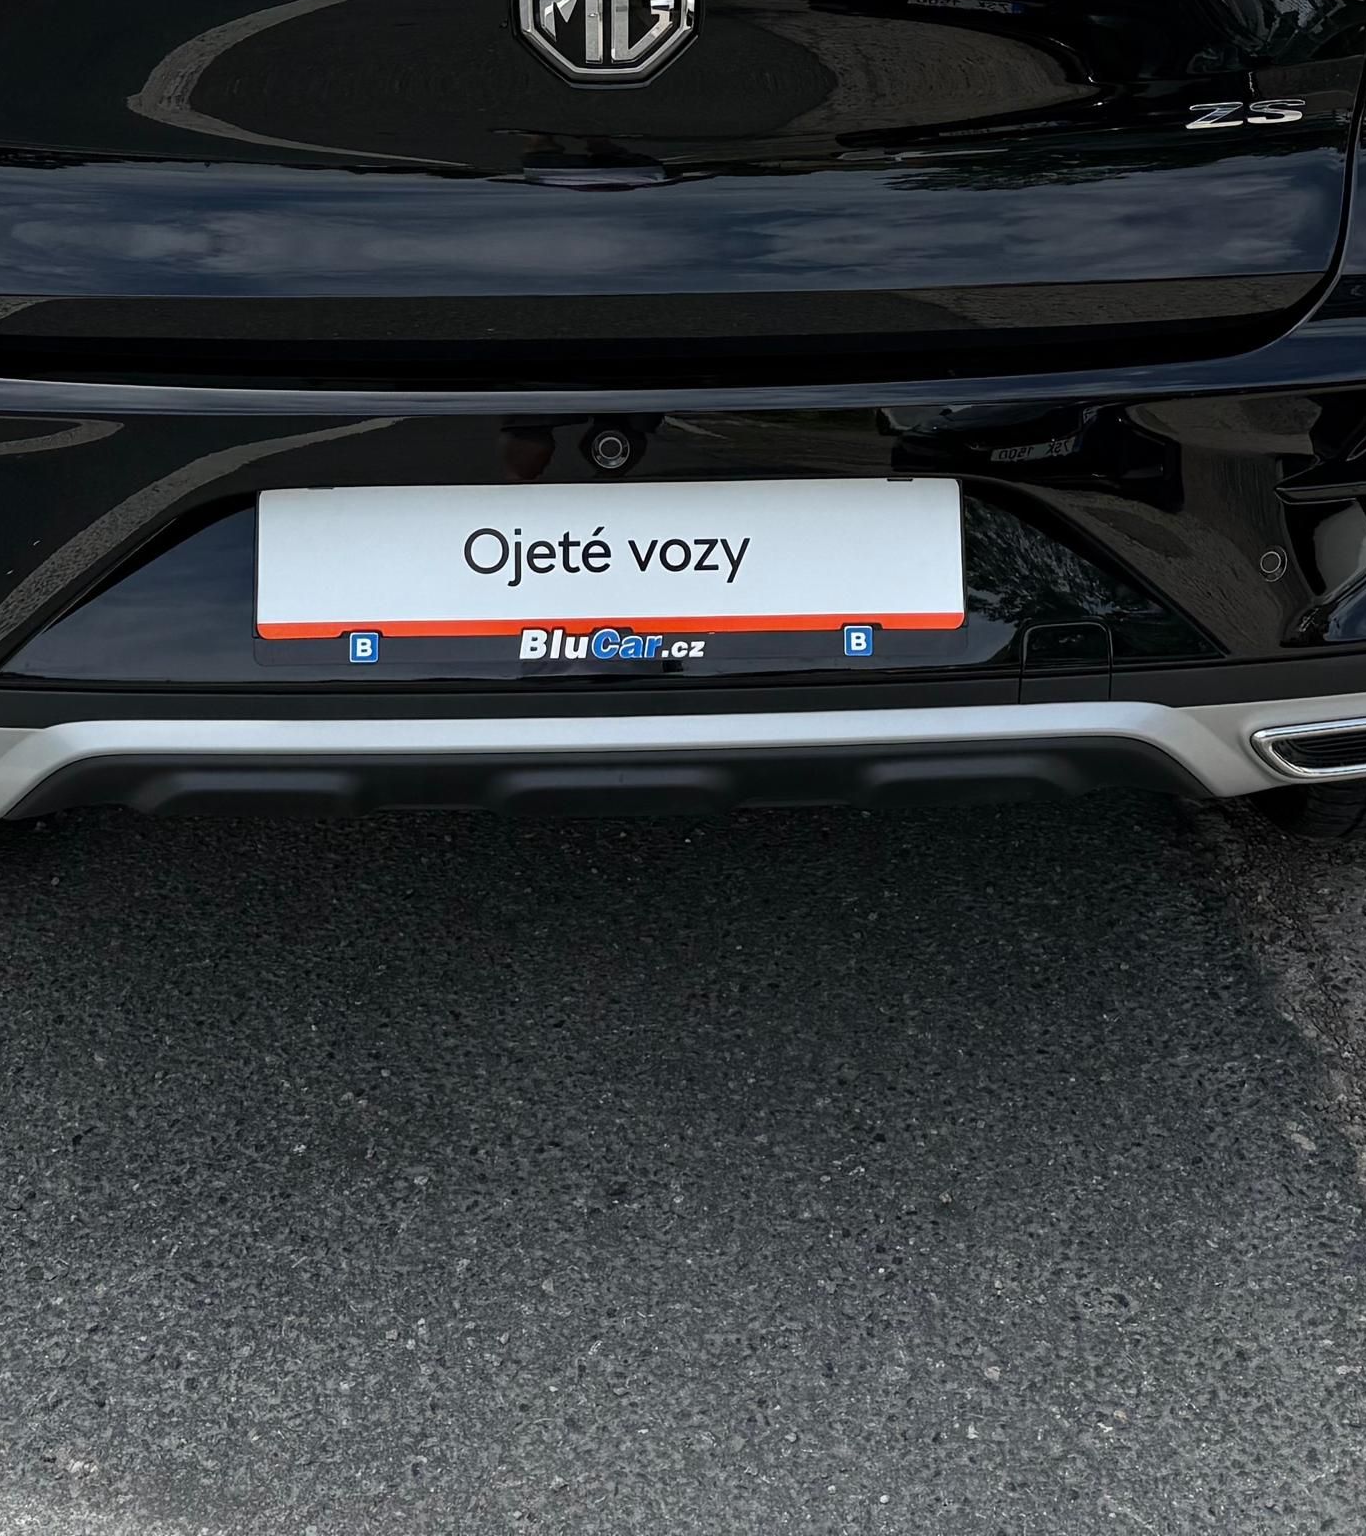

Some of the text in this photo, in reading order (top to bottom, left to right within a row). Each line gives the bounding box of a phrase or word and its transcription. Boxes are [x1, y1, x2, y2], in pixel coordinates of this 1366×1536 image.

[1186, 99, 1306, 129] ZS
[464, 526, 751, 587] Ojeté vozy
[356, 638, 373, 657] B
[519, 628, 706, 660] BluCar.cz
[850, 632, 867, 651] B
